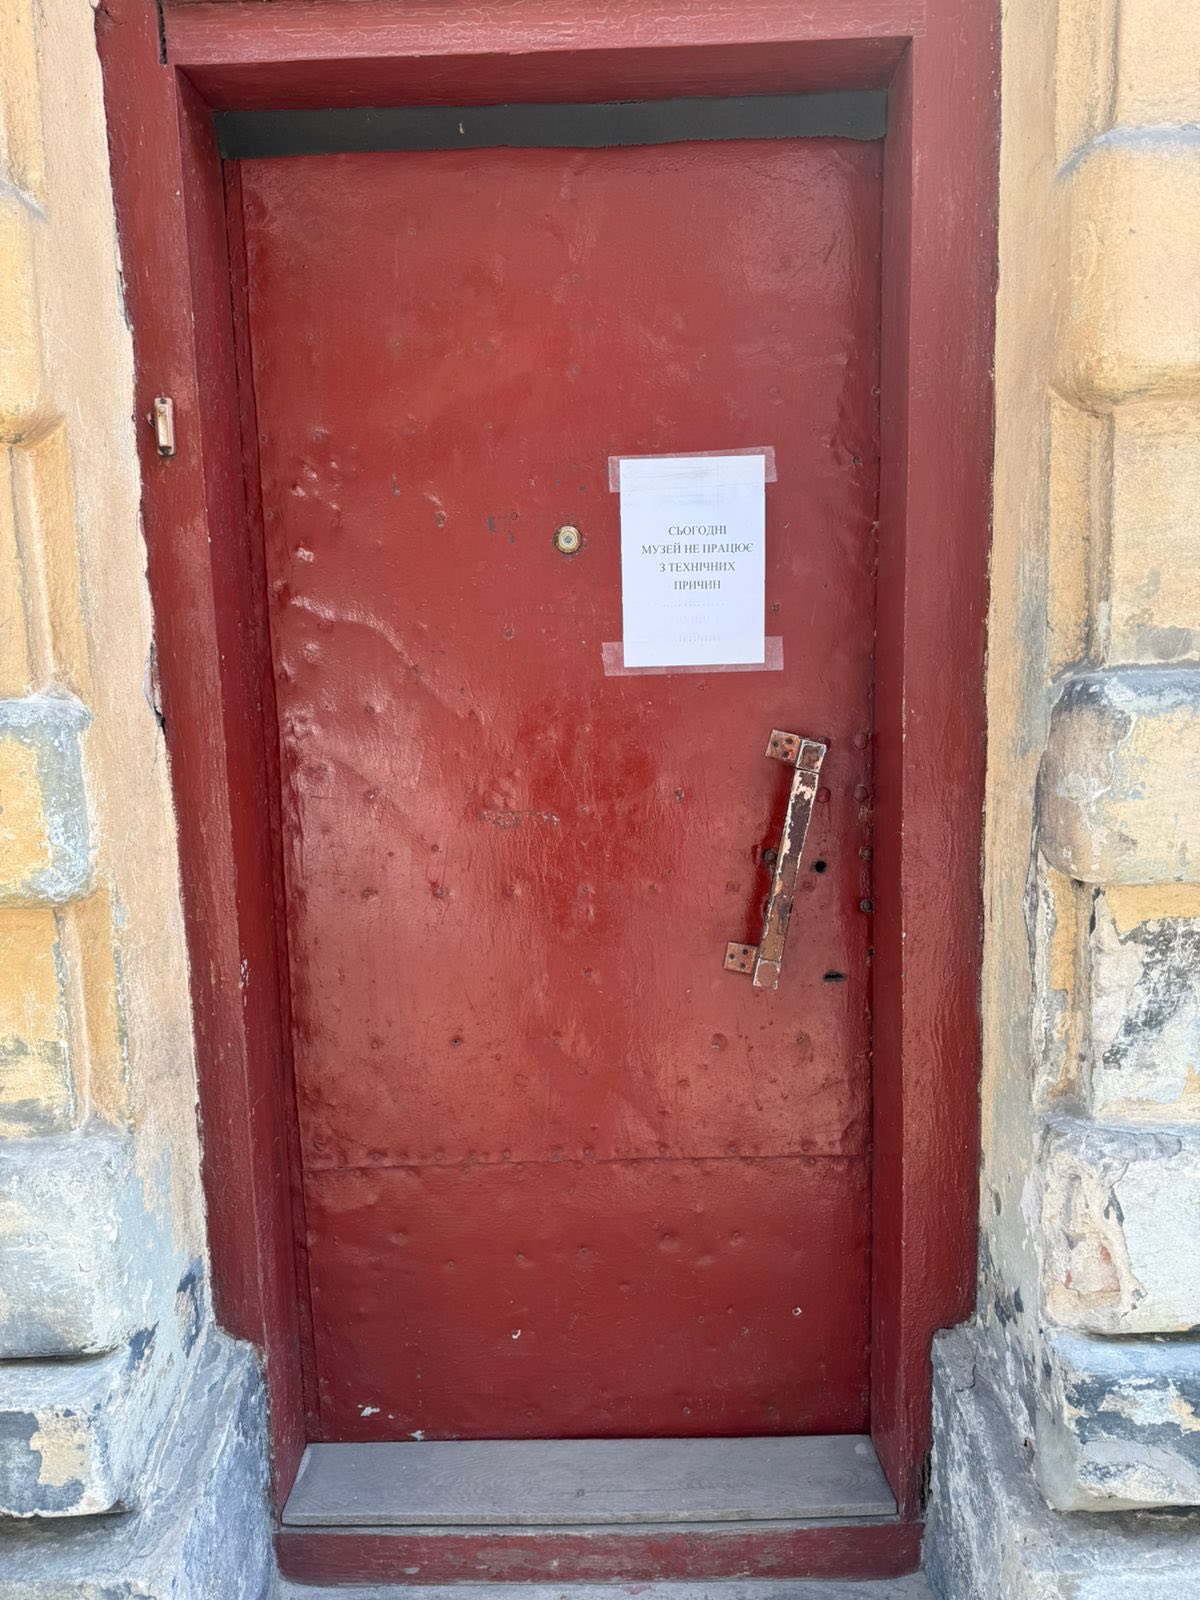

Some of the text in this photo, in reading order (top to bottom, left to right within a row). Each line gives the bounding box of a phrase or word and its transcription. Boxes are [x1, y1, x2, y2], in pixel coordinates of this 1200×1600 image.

[668, 525, 727, 536] СЬОГОДНІ
[642, 542, 754, 554] МУЗЕЙ НЕ ПРАЦЮЄ
[659, 561, 736, 572] З ТЕХНІЧНИХ
[674, 580, 721, 590] ПРИЧИН
